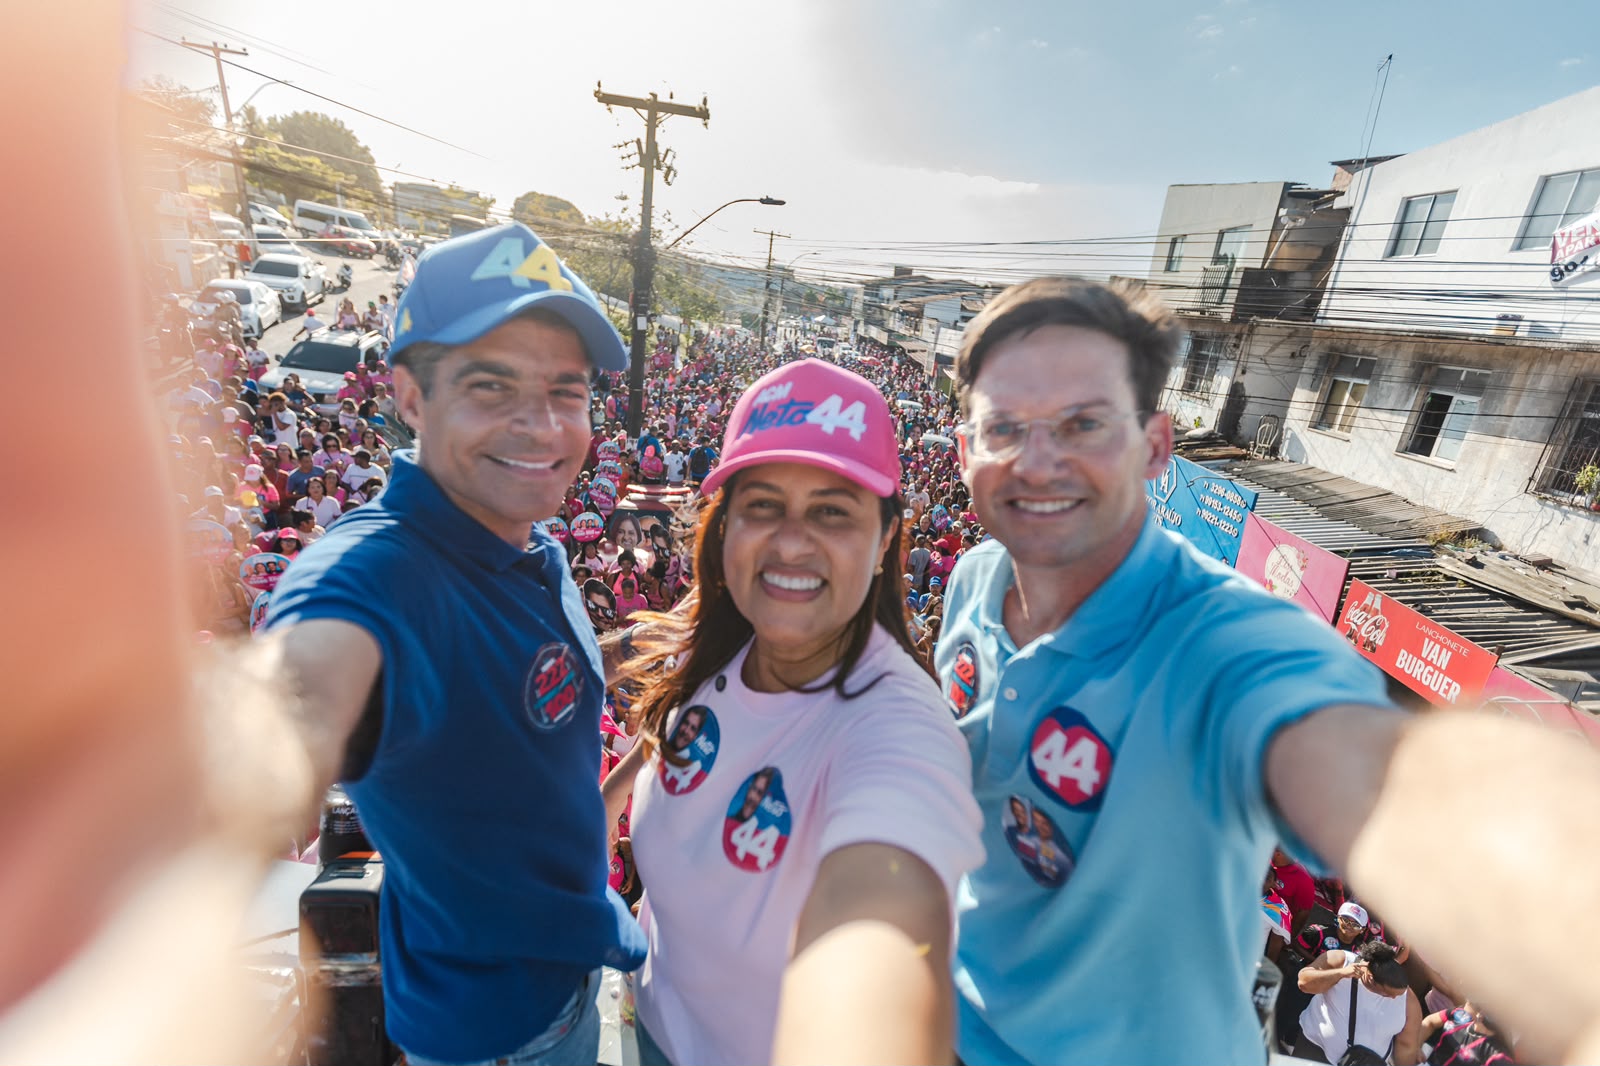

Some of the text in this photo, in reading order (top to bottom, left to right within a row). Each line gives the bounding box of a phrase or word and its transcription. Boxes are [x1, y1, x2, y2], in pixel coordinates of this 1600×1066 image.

[470, 237, 574, 292] 44
[737, 394, 868, 442] Neto 44
[1156, 503, 1183, 527] ARAÚJO
[1344, 600, 1390, 647] Coca-Cola
[1415, 621, 1470, 658] LANCHONETE
[1395, 648, 1461, 705] BURGUER
[1421, 637, 1453, 671] VAN
[1032, 728, 1102, 797] 44
[730, 815, 780, 871] 44
